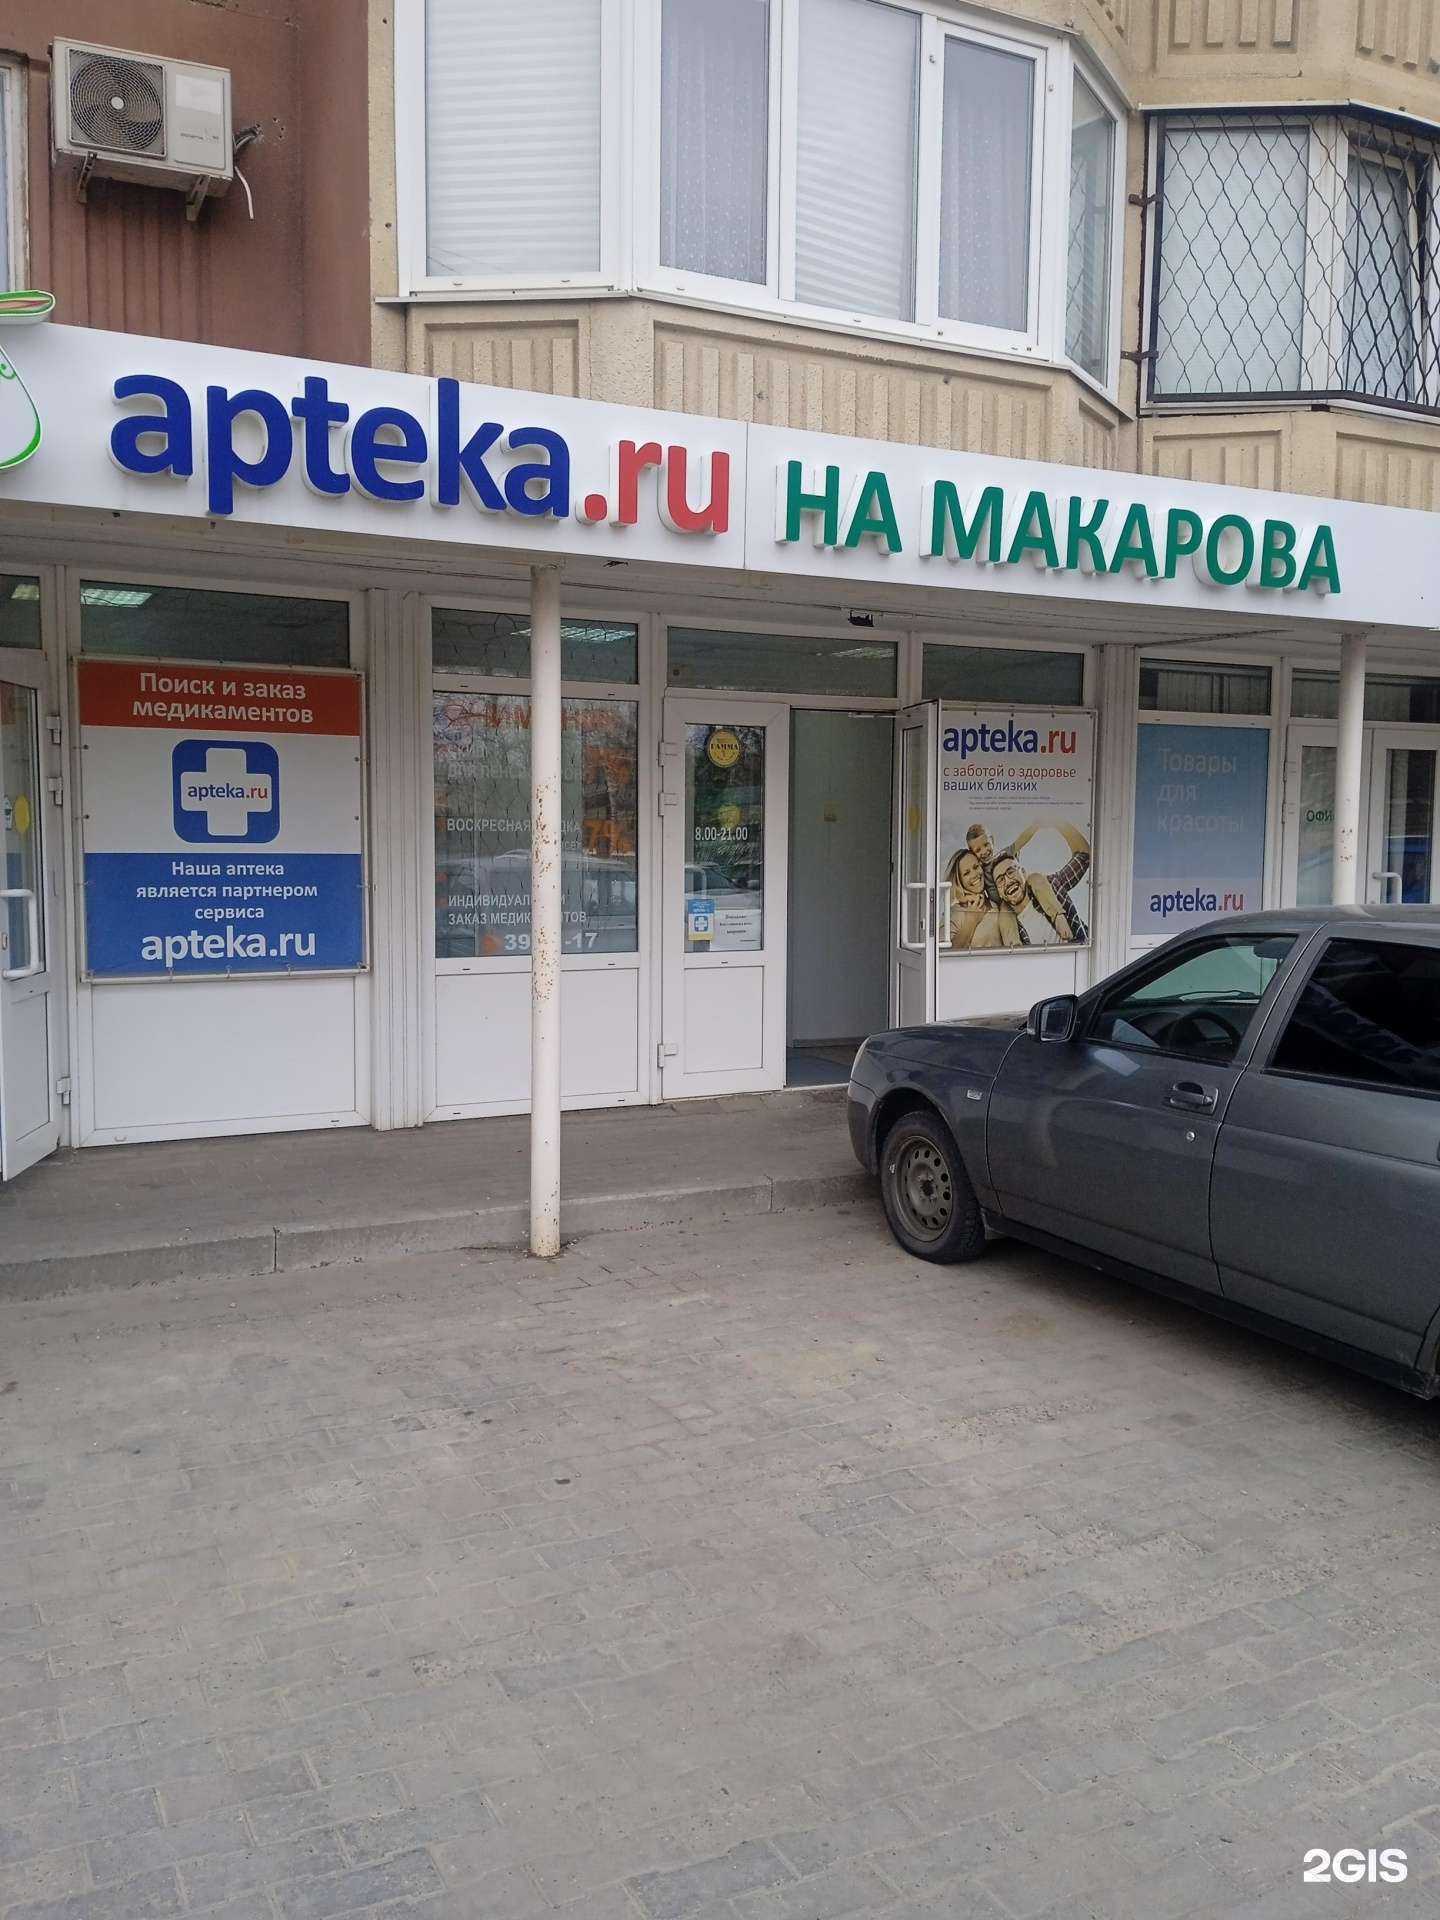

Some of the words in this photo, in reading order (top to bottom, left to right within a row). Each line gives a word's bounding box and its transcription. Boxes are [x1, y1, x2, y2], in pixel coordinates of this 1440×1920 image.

[111, 375, 730, 533] apteka.ru
[786, 461, 903, 553] НА
[930, 480, 1341, 594] МАКАРОВА
[139, 672, 215, 695] Поиск
[222, 681, 237, 697] и
[243, 682, 306, 700] заказ
[132, 700, 314, 724] медикаментов
[942, 720, 1077, 760] apteka.ru
[943, 767, 950, 777] с
[953, 764, 1004, 777] заботой
[1007, 769, 1016, 778] о
[1018, 767, 1077, 780] здоровье
[187, 783, 269, 801] apteka.ru
[943, 781, 984, 792] ваших
[986, 778, 1038, 792] близких
[1306, 810, 1335, 823] ОФИ
[447, 818, 531, 832] ВОСКРЕСНАЯ
[695, 826, 749, 841] 8.00-21.00
[171, 861, 221, 876] Наша
[226, 863, 285, 876] аптека
[136, 885, 217, 898] является
[222, 884, 318, 900] партнером
[1150, 887, 1244, 918] apteka.ru
[194, 906, 265, 922] сервиса
[448, 912, 487, 925] ЗАКАЗ
[141, 925, 317, 968] apteka.ru
